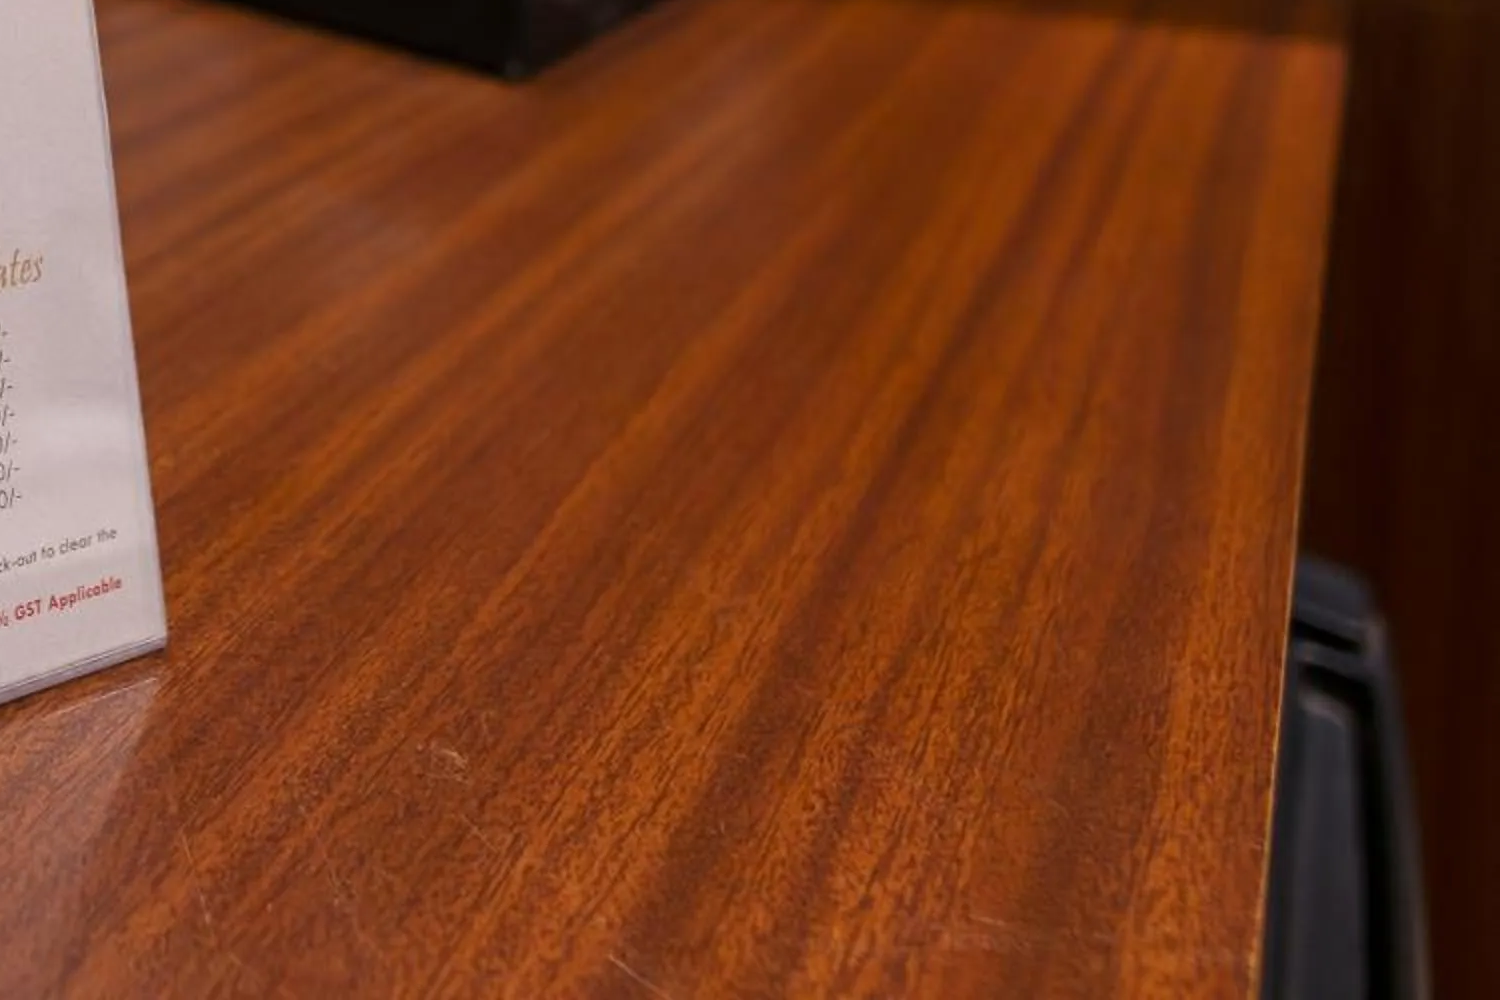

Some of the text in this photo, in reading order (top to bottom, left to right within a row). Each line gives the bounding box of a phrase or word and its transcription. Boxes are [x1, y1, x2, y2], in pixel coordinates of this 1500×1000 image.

[40, 544, 55, 560] to
[59, 533, 93, 556] clear
[95, 525, 118, 544] the
[14, 598, 43, 622] GST
[48, 574, 124, 612] Applicable
